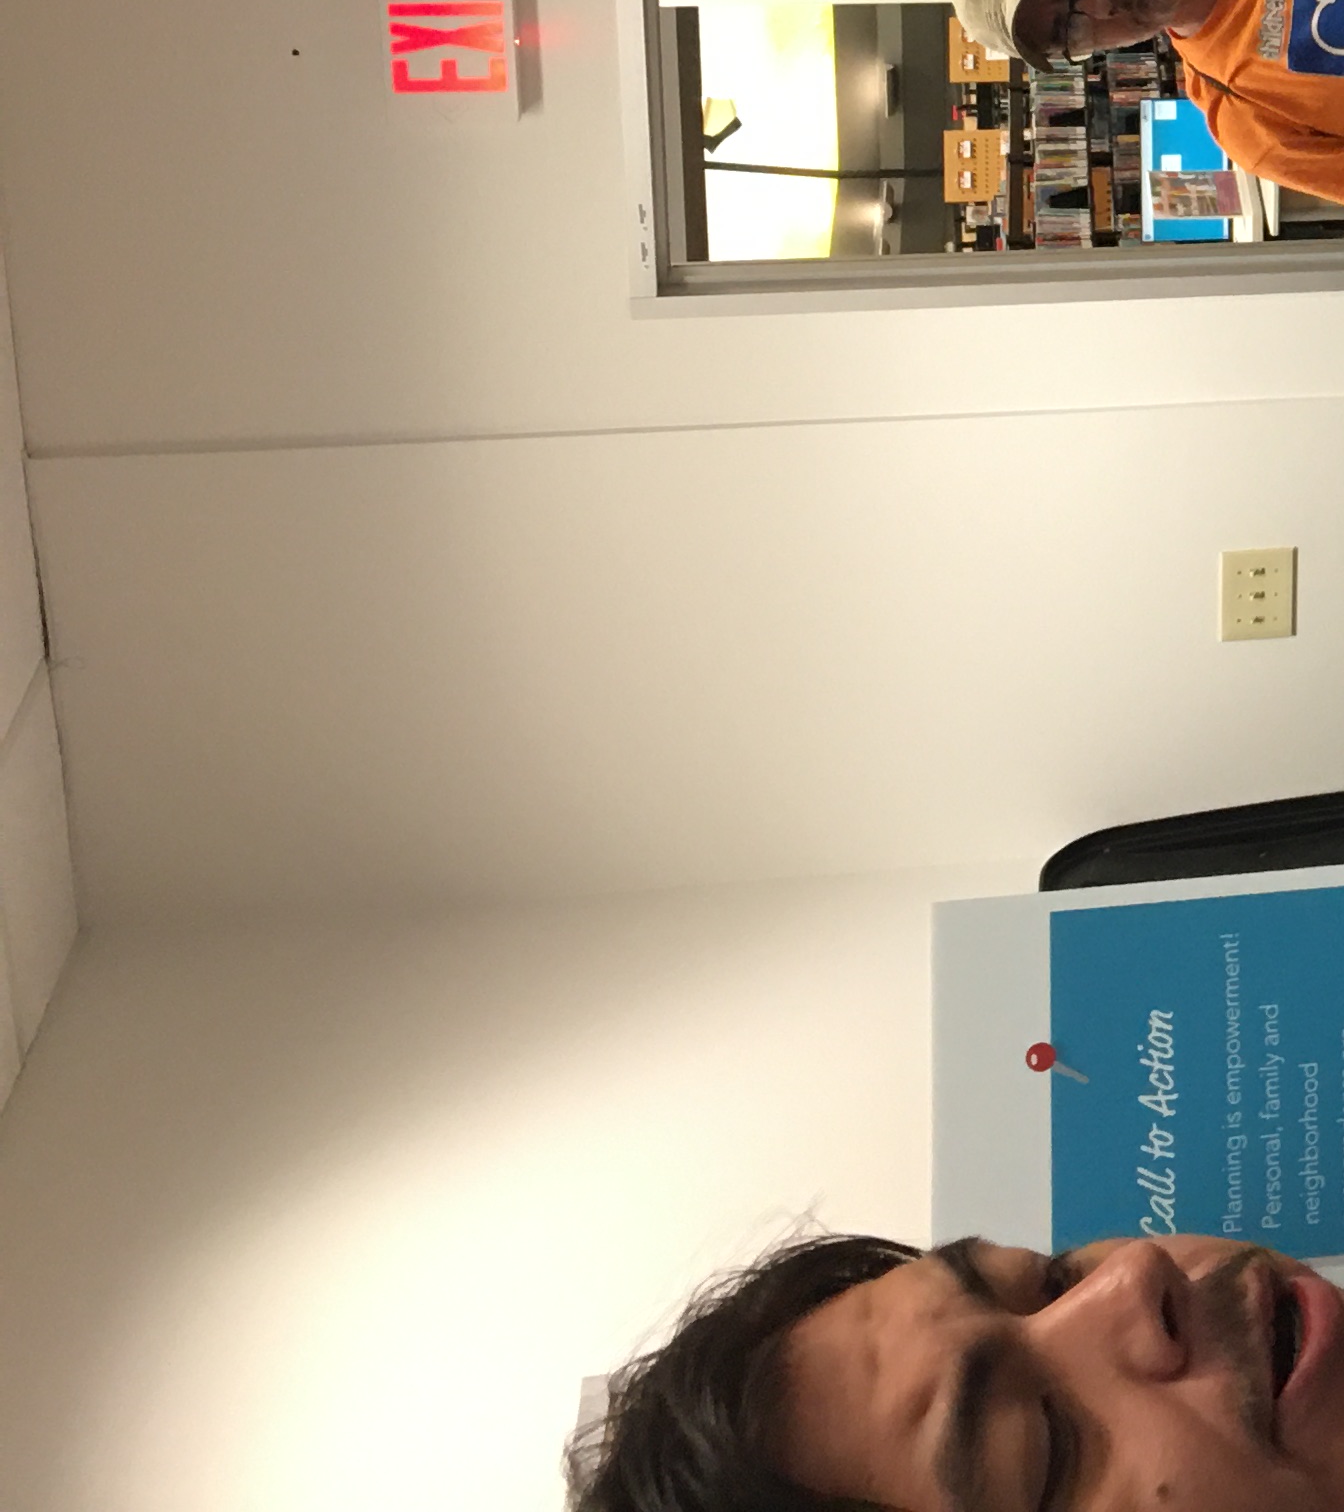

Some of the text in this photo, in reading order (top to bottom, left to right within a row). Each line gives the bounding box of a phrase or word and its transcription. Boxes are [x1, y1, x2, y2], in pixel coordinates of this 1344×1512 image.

[1137, 1010, 1178, 1236] Call to Action
[1220, 932, 1247, 1233] Planning is empowerment!
[1259, 1003, 1285, 1228] Personal, family and
[1298, 1062, 1325, 1224] neighborhood
